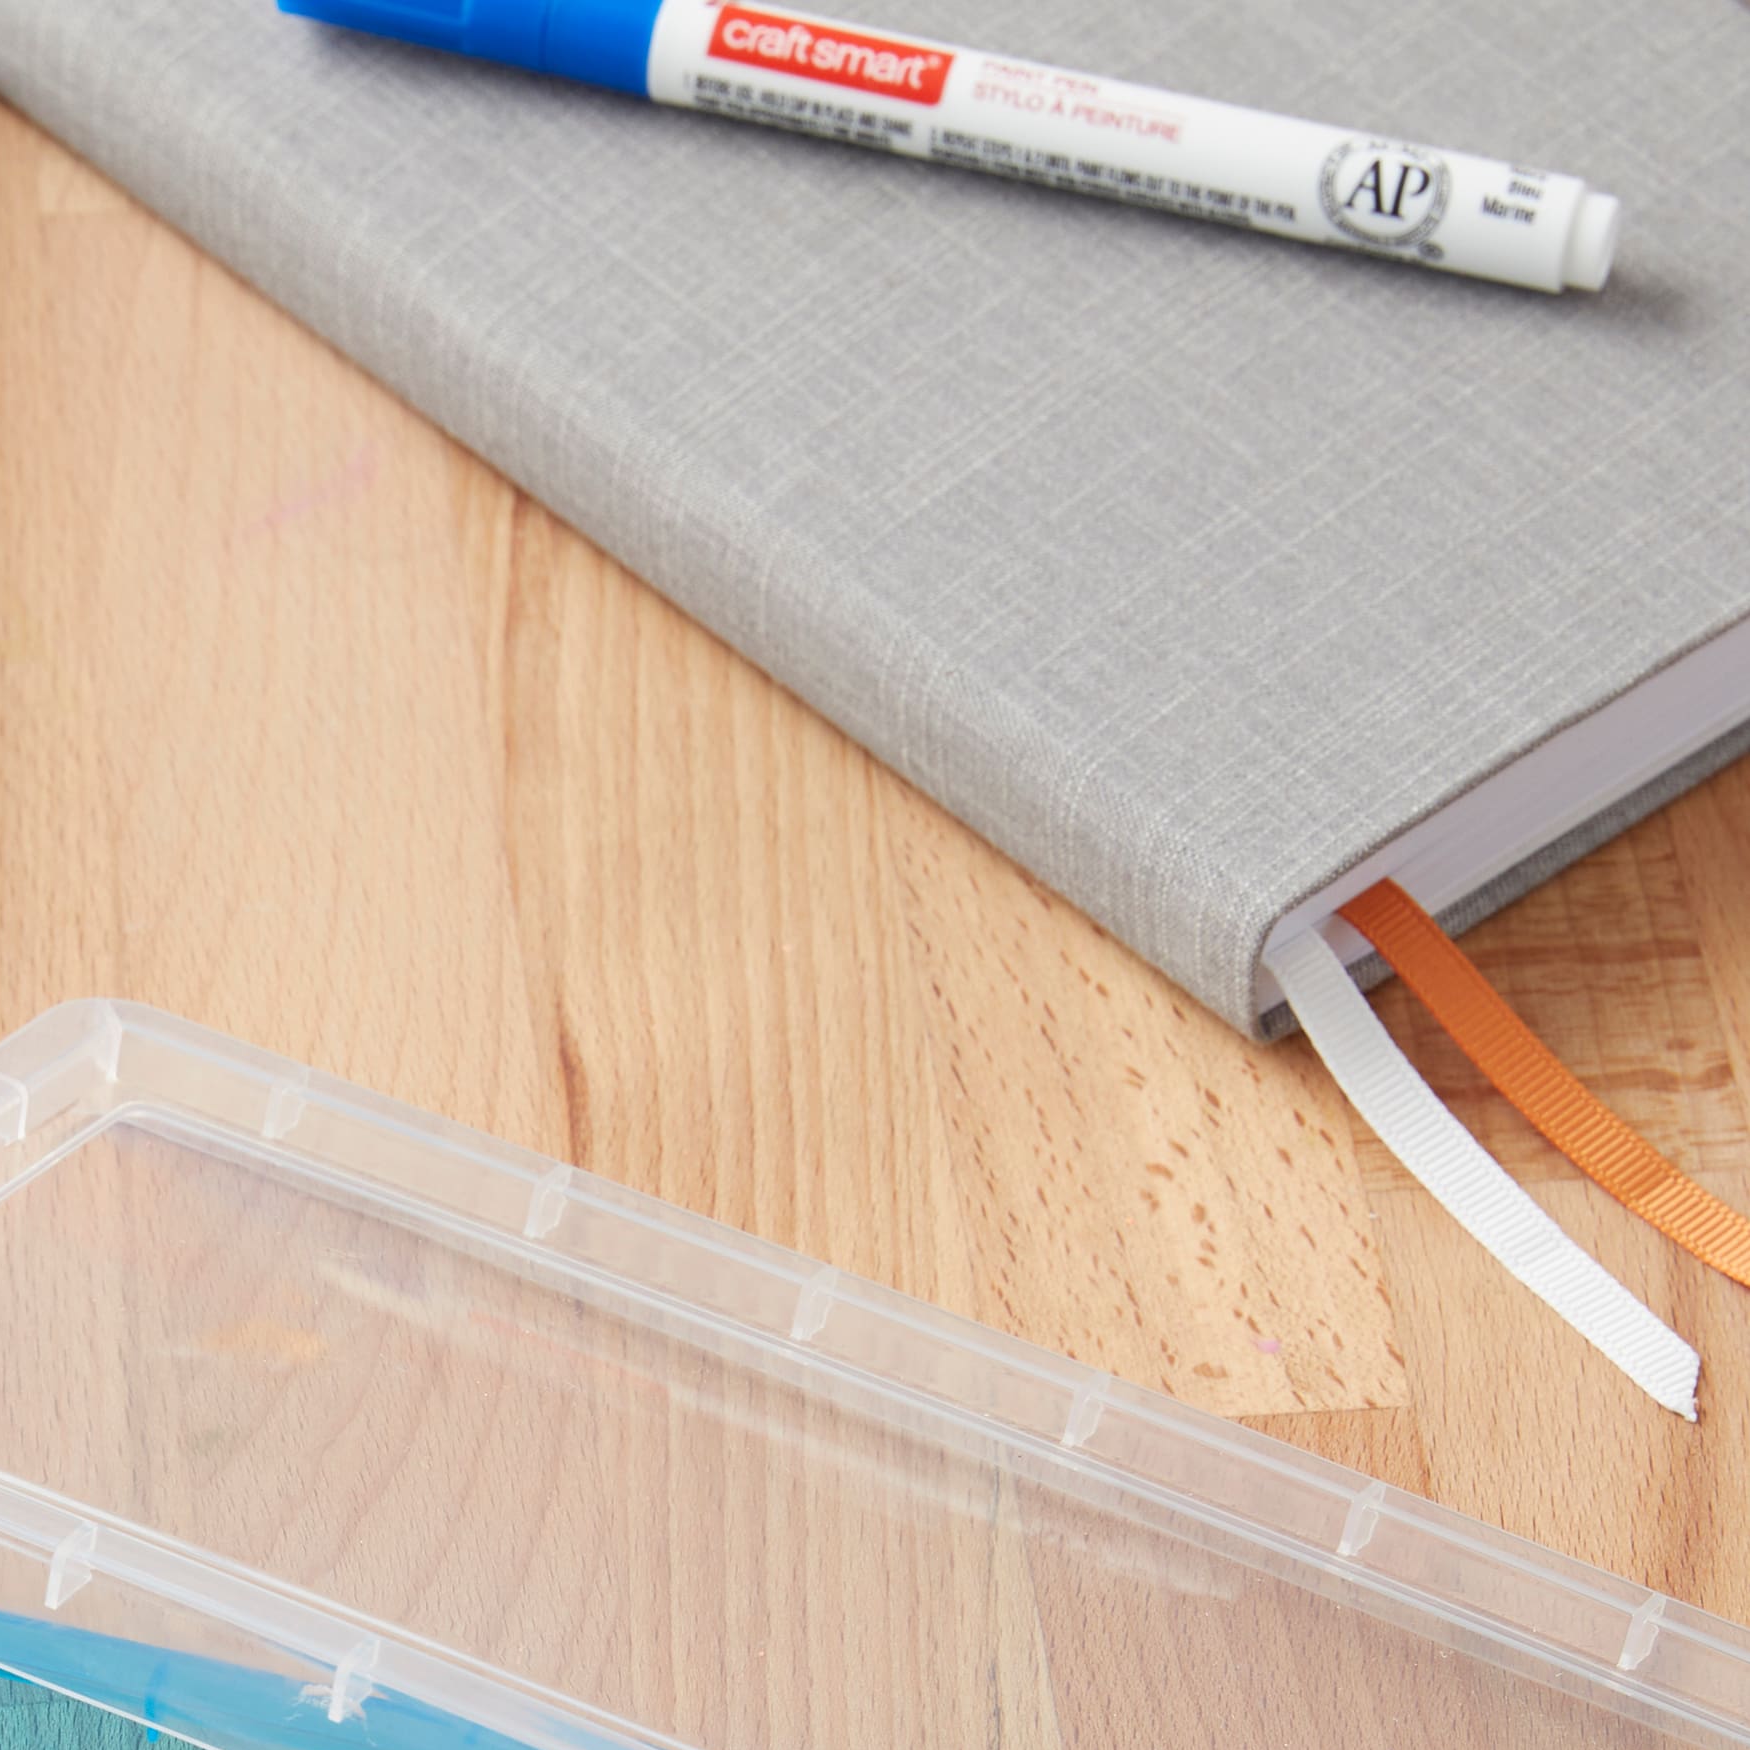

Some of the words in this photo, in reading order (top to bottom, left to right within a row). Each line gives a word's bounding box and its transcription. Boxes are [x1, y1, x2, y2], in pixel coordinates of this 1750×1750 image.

[721, 18, 812, 65] craft
[972, 82, 1044, 113] STYLO
[1070, 102, 1183, 144] PEINTURE
[1345, 160, 1430, 218] AP
